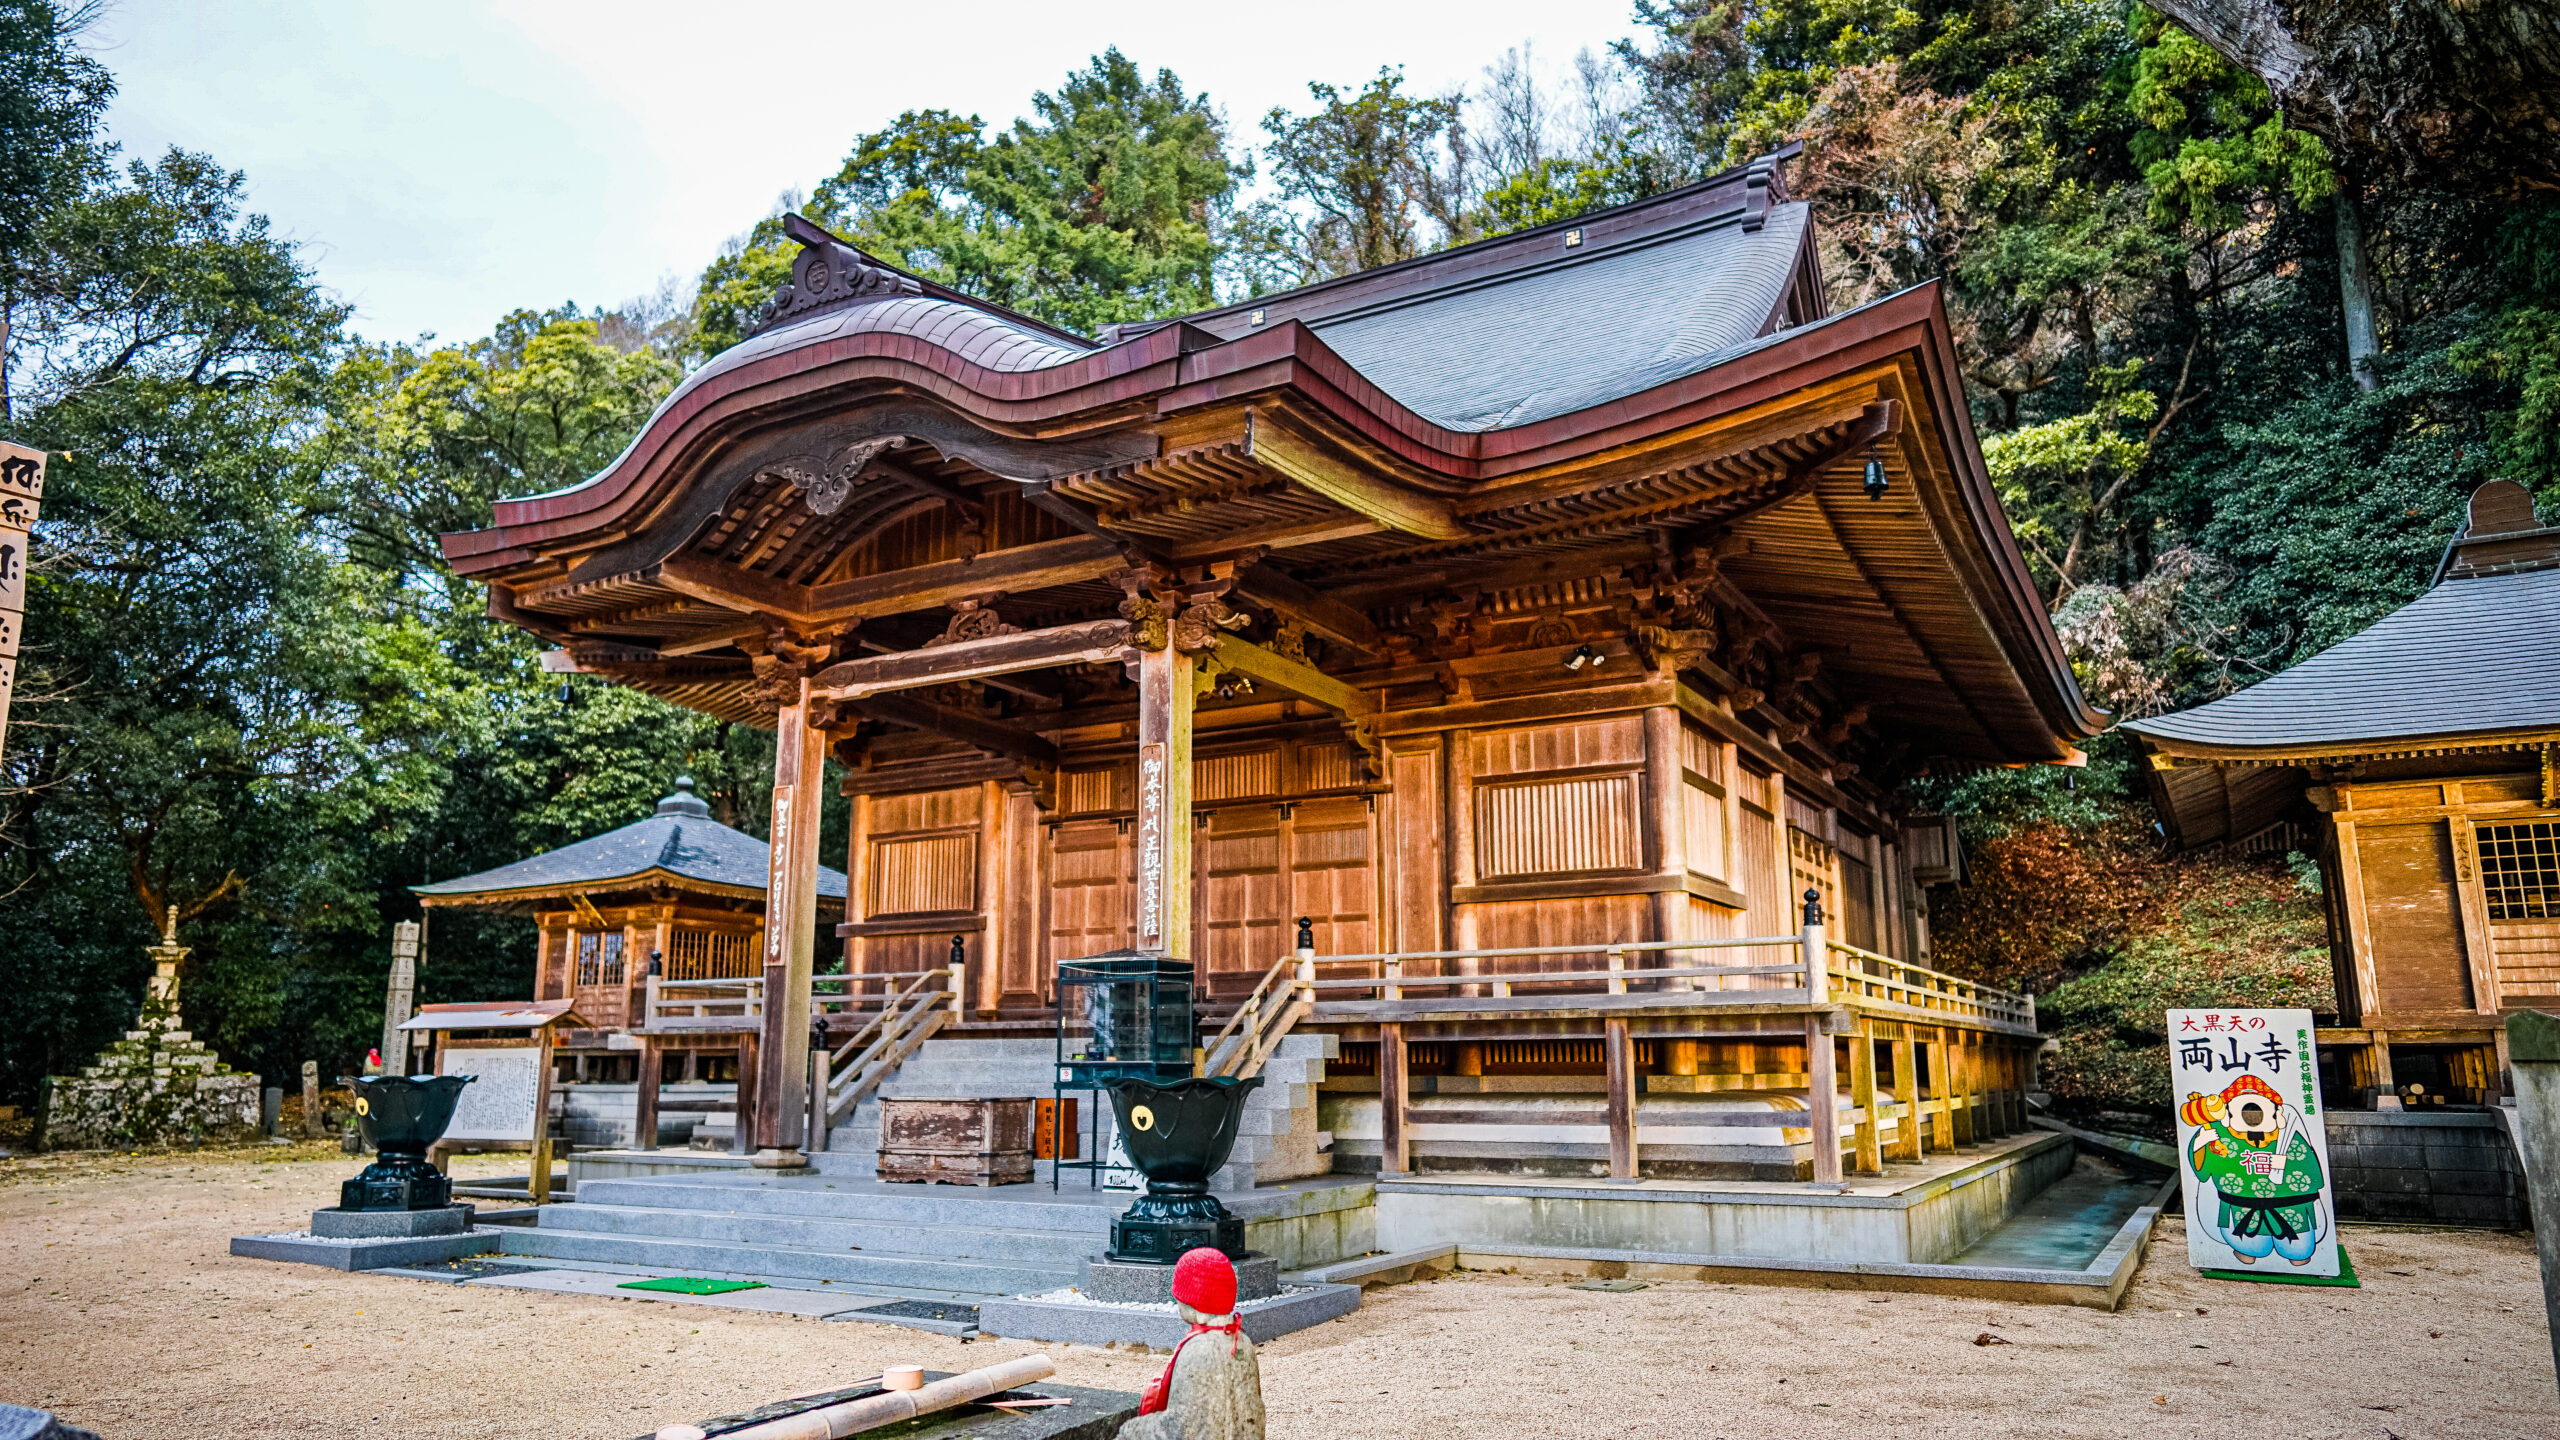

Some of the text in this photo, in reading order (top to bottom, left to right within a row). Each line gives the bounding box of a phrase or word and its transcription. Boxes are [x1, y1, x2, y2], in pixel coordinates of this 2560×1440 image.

[2180, 1014, 2266, 1032] 大黒天の
[2177, 1031, 2292, 1074] 両山寺
[2240, 1149, 2272, 1175] 福
